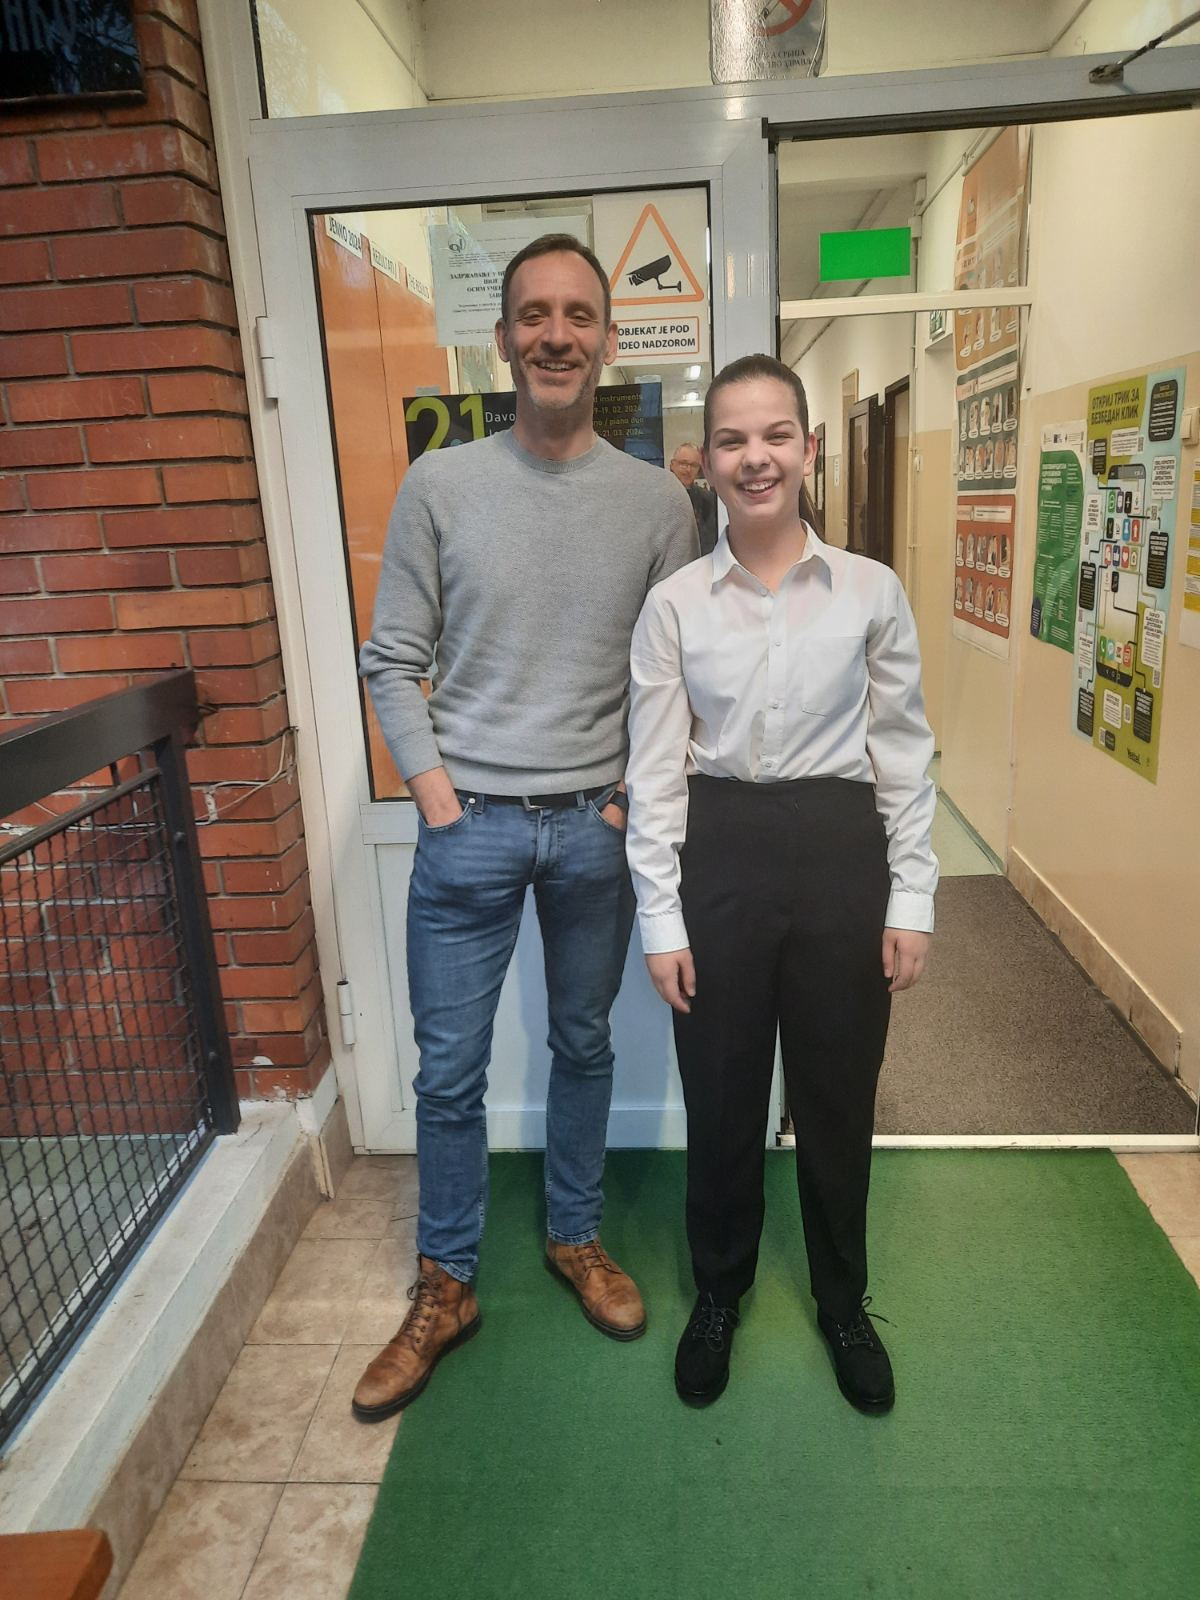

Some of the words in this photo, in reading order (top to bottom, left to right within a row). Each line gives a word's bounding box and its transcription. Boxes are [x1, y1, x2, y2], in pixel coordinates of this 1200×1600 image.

[617, 326, 657, 336] OBJEKAT
[658, 325, 668, 334] JE
[670, 324, 690, 333] POD
[618, 341, 640, 350] IDEO
[642, 338, 696, 348] NADZOROM
[1130, 387, 1140, 402] ЗА
[405, 394, 485, 450] 21
[485, 411, 516, 423] Davo
